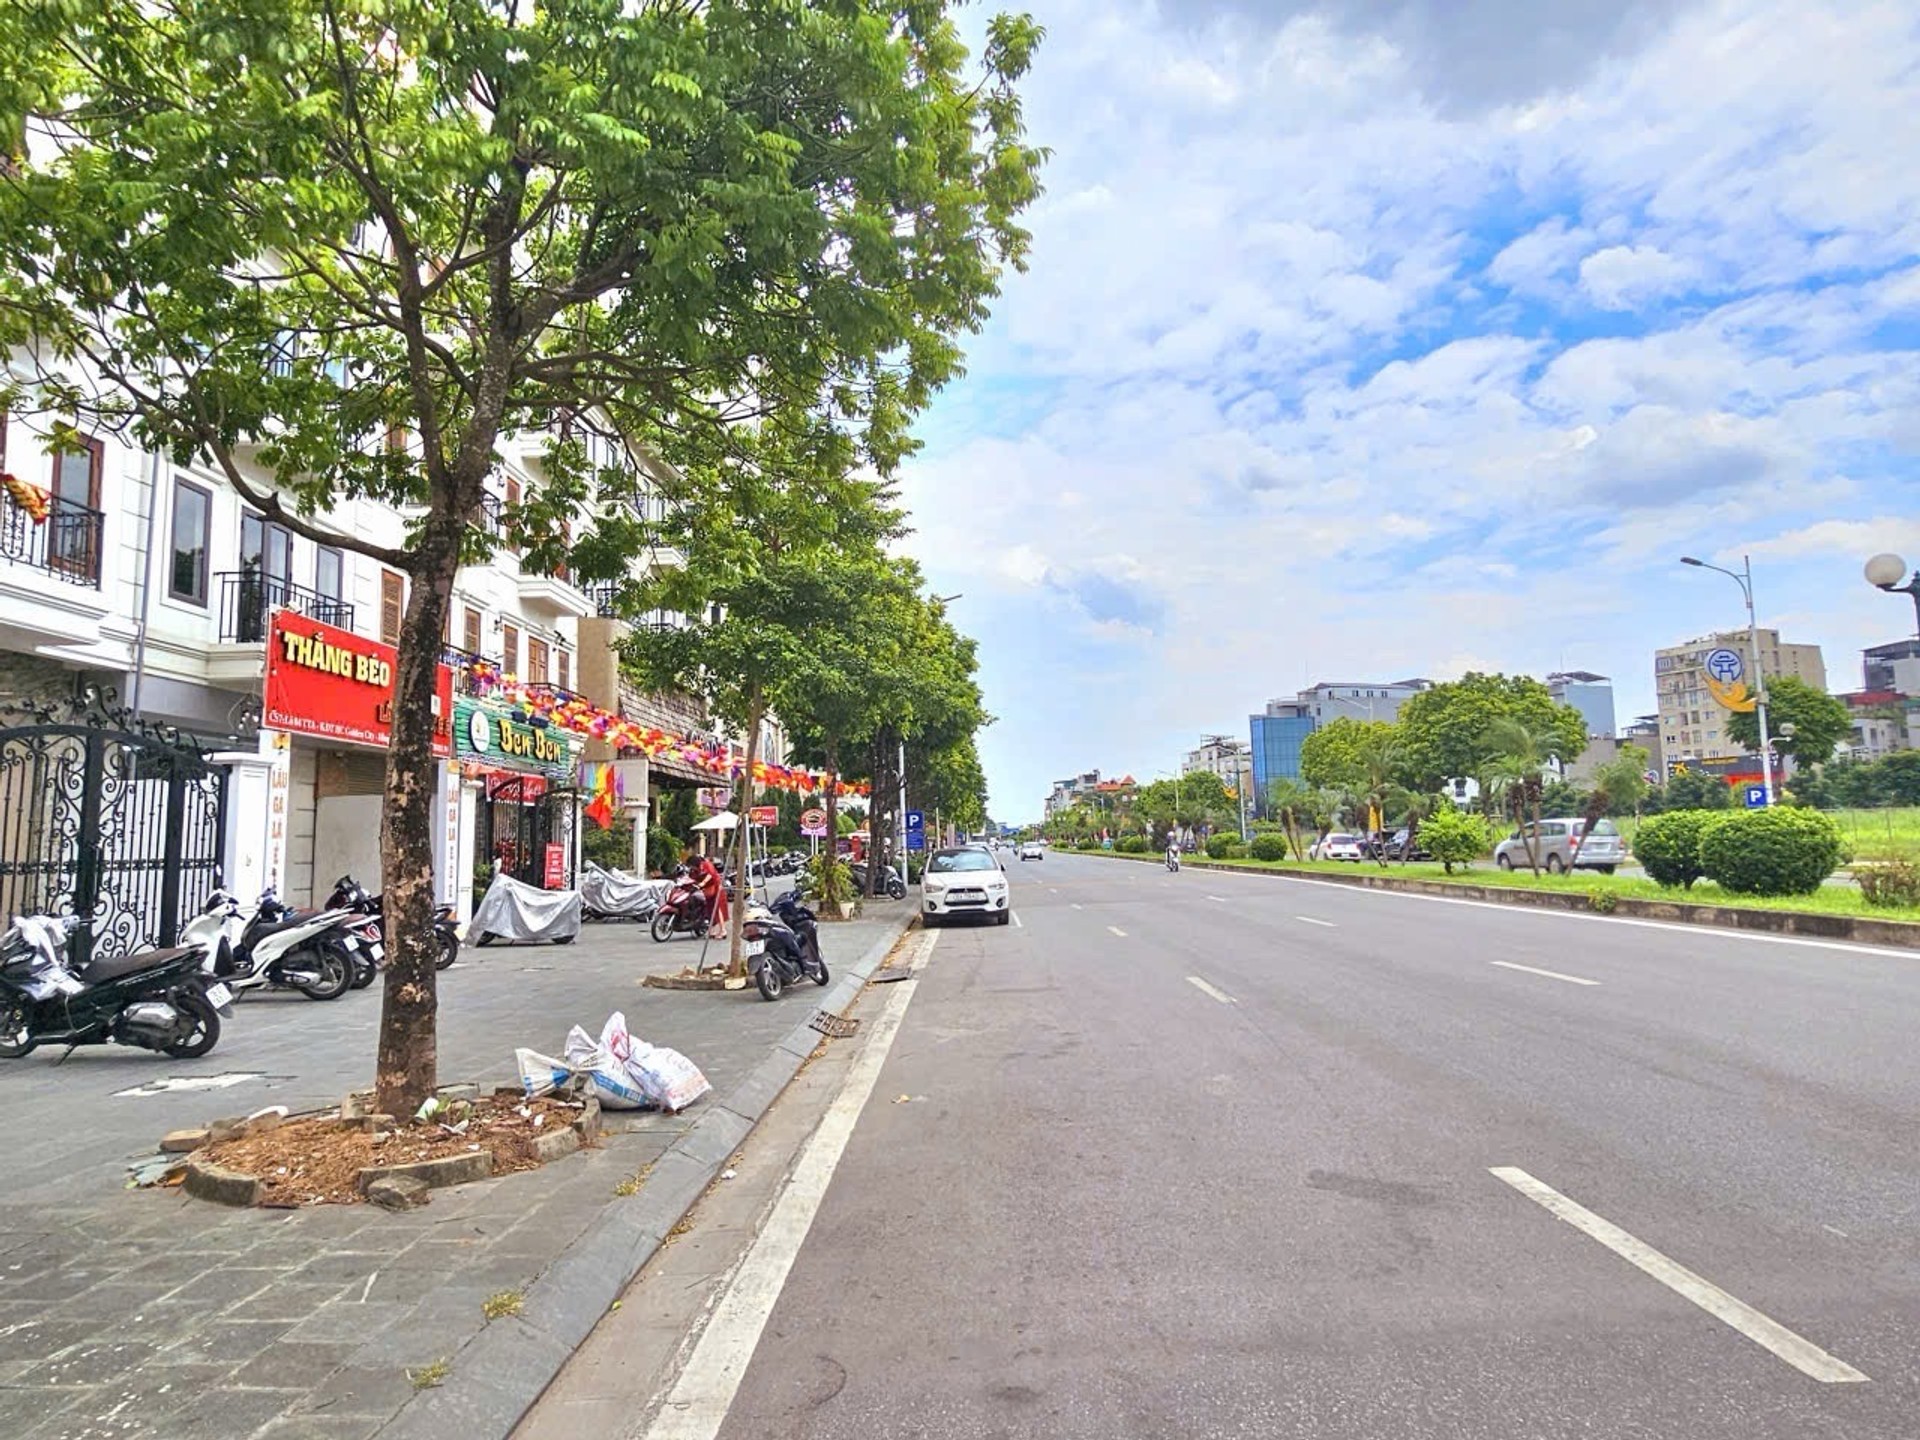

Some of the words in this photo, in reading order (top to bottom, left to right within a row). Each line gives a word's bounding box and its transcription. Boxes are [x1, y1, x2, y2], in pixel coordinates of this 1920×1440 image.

[356, 652, 391, 688] BÉO
[1750, 790, 1762, 802] P
[909, 814, 920, 827] P
